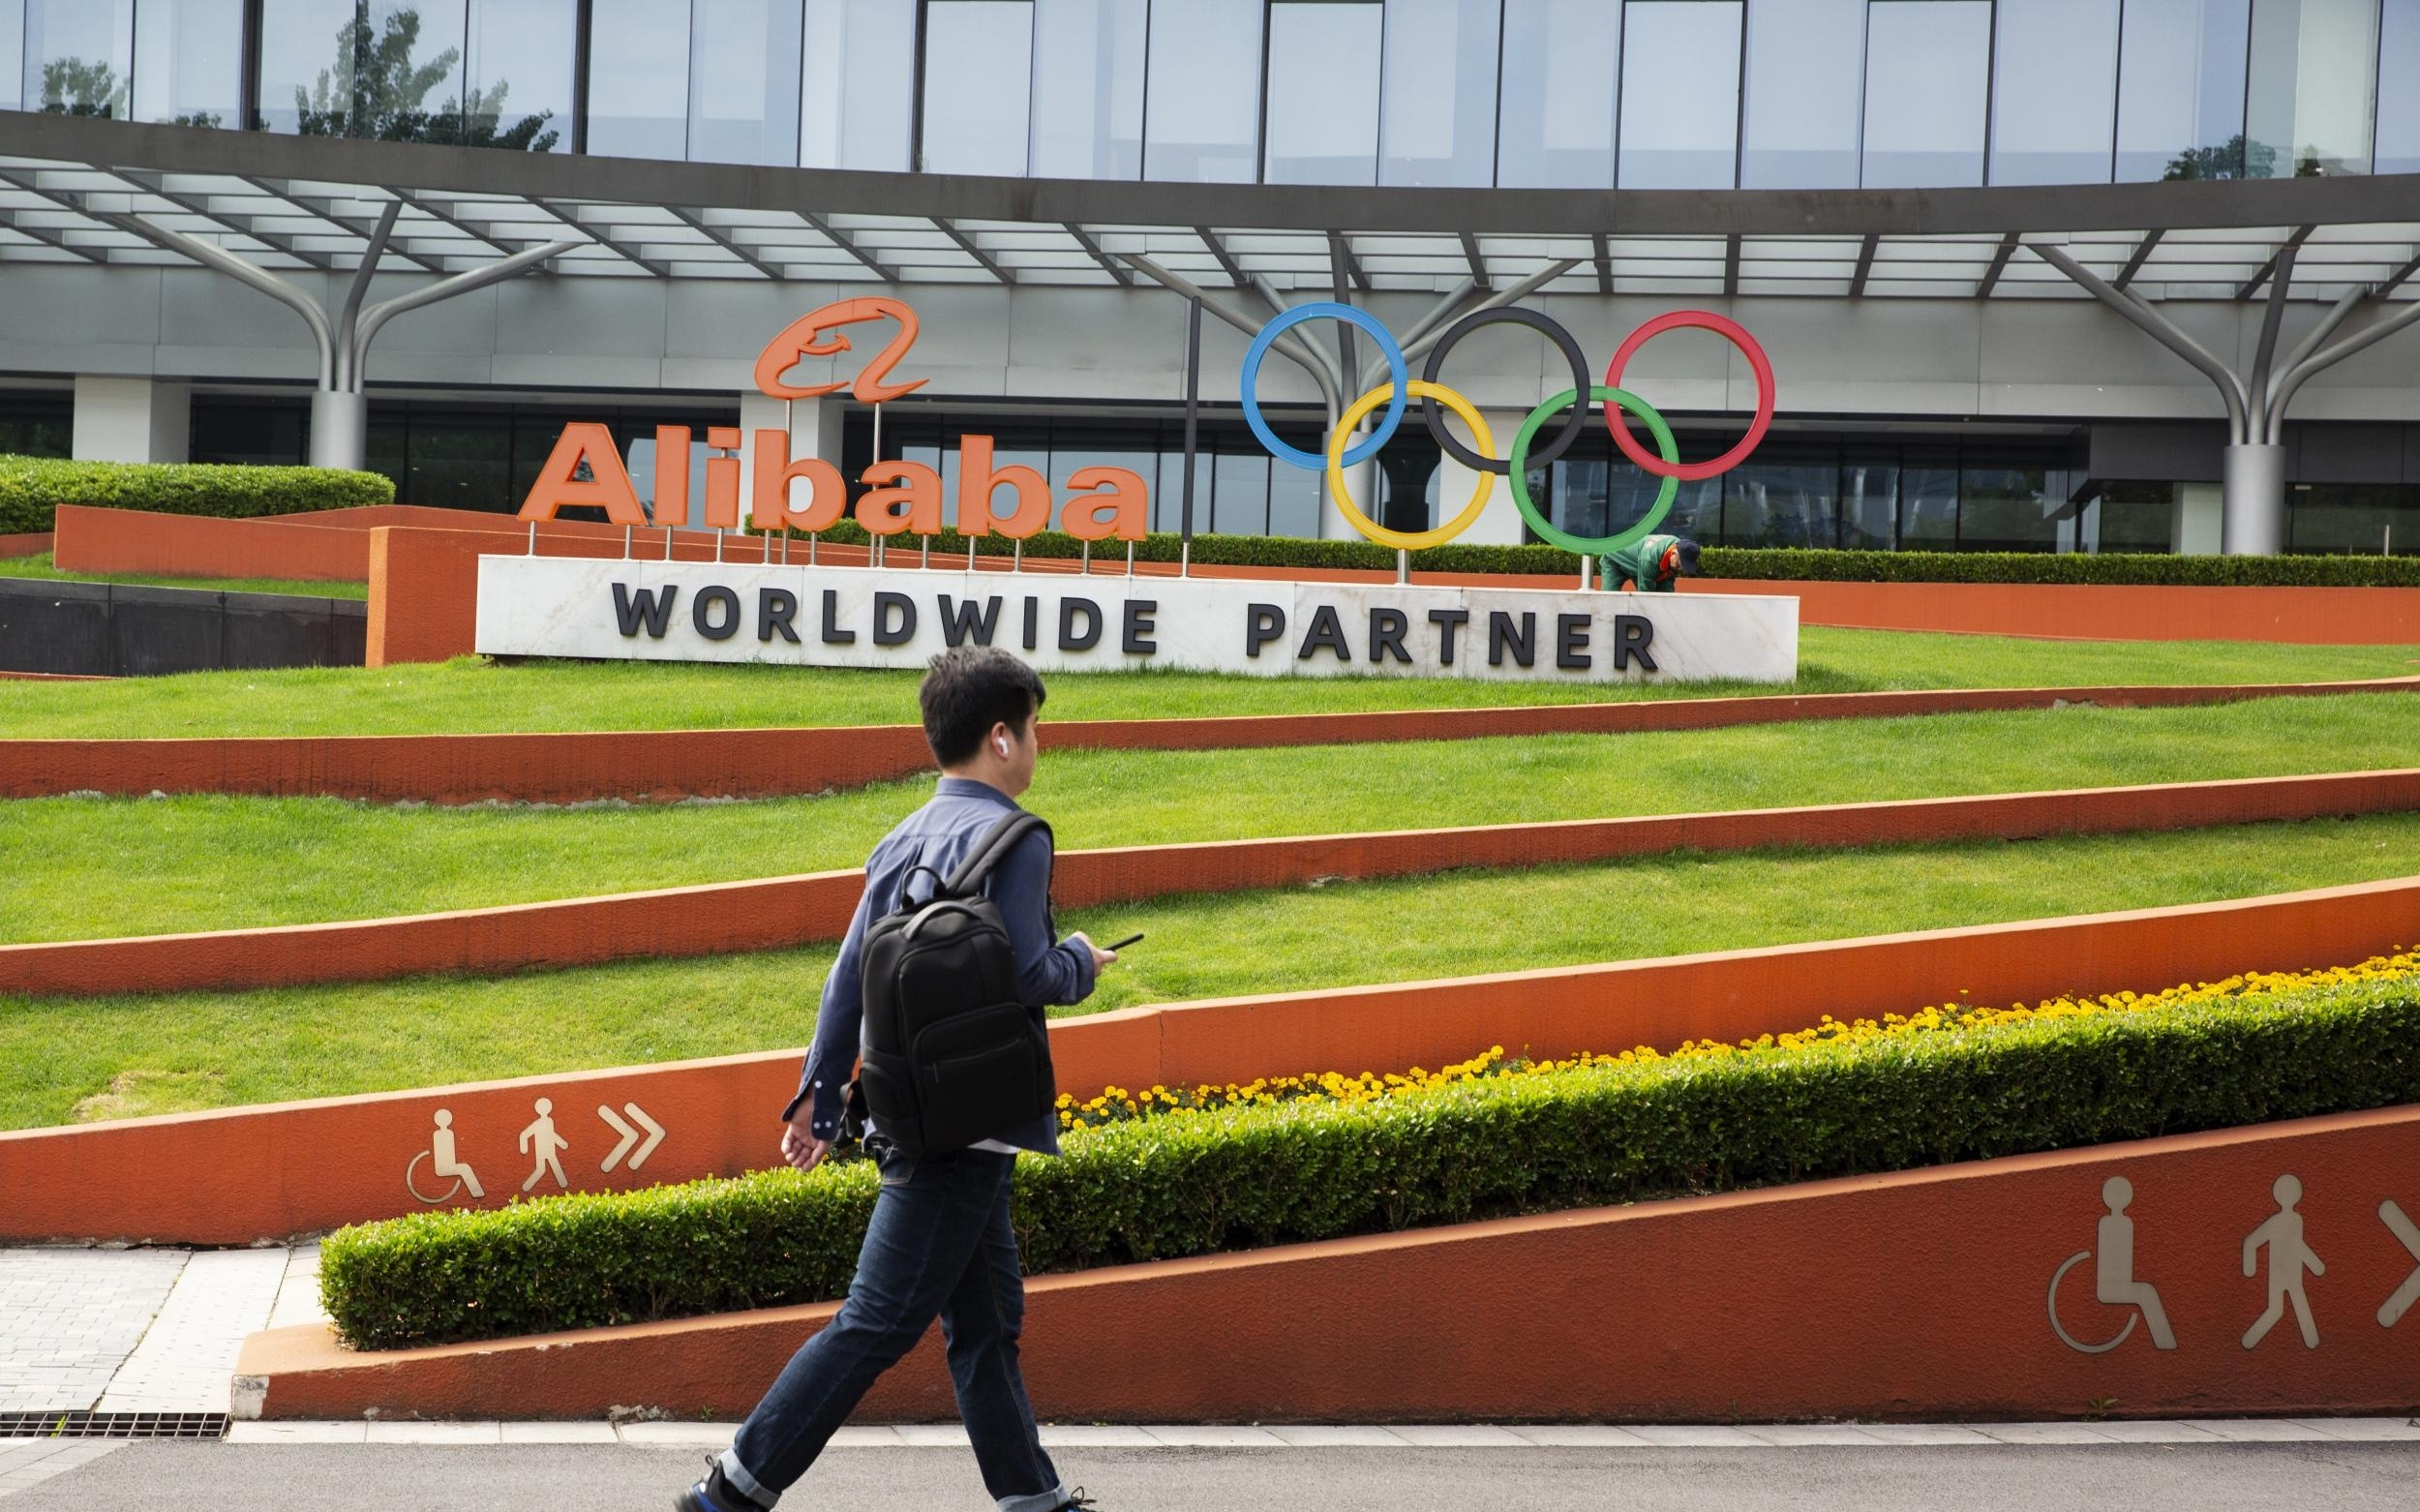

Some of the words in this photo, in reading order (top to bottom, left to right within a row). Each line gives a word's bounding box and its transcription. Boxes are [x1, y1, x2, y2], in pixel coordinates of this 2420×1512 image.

[517, 422, 1148, 541] Alibaba
[612, 583, 1157, 653] WORLDWIDE
[1246, 603, 1658, 671] PARTNER
